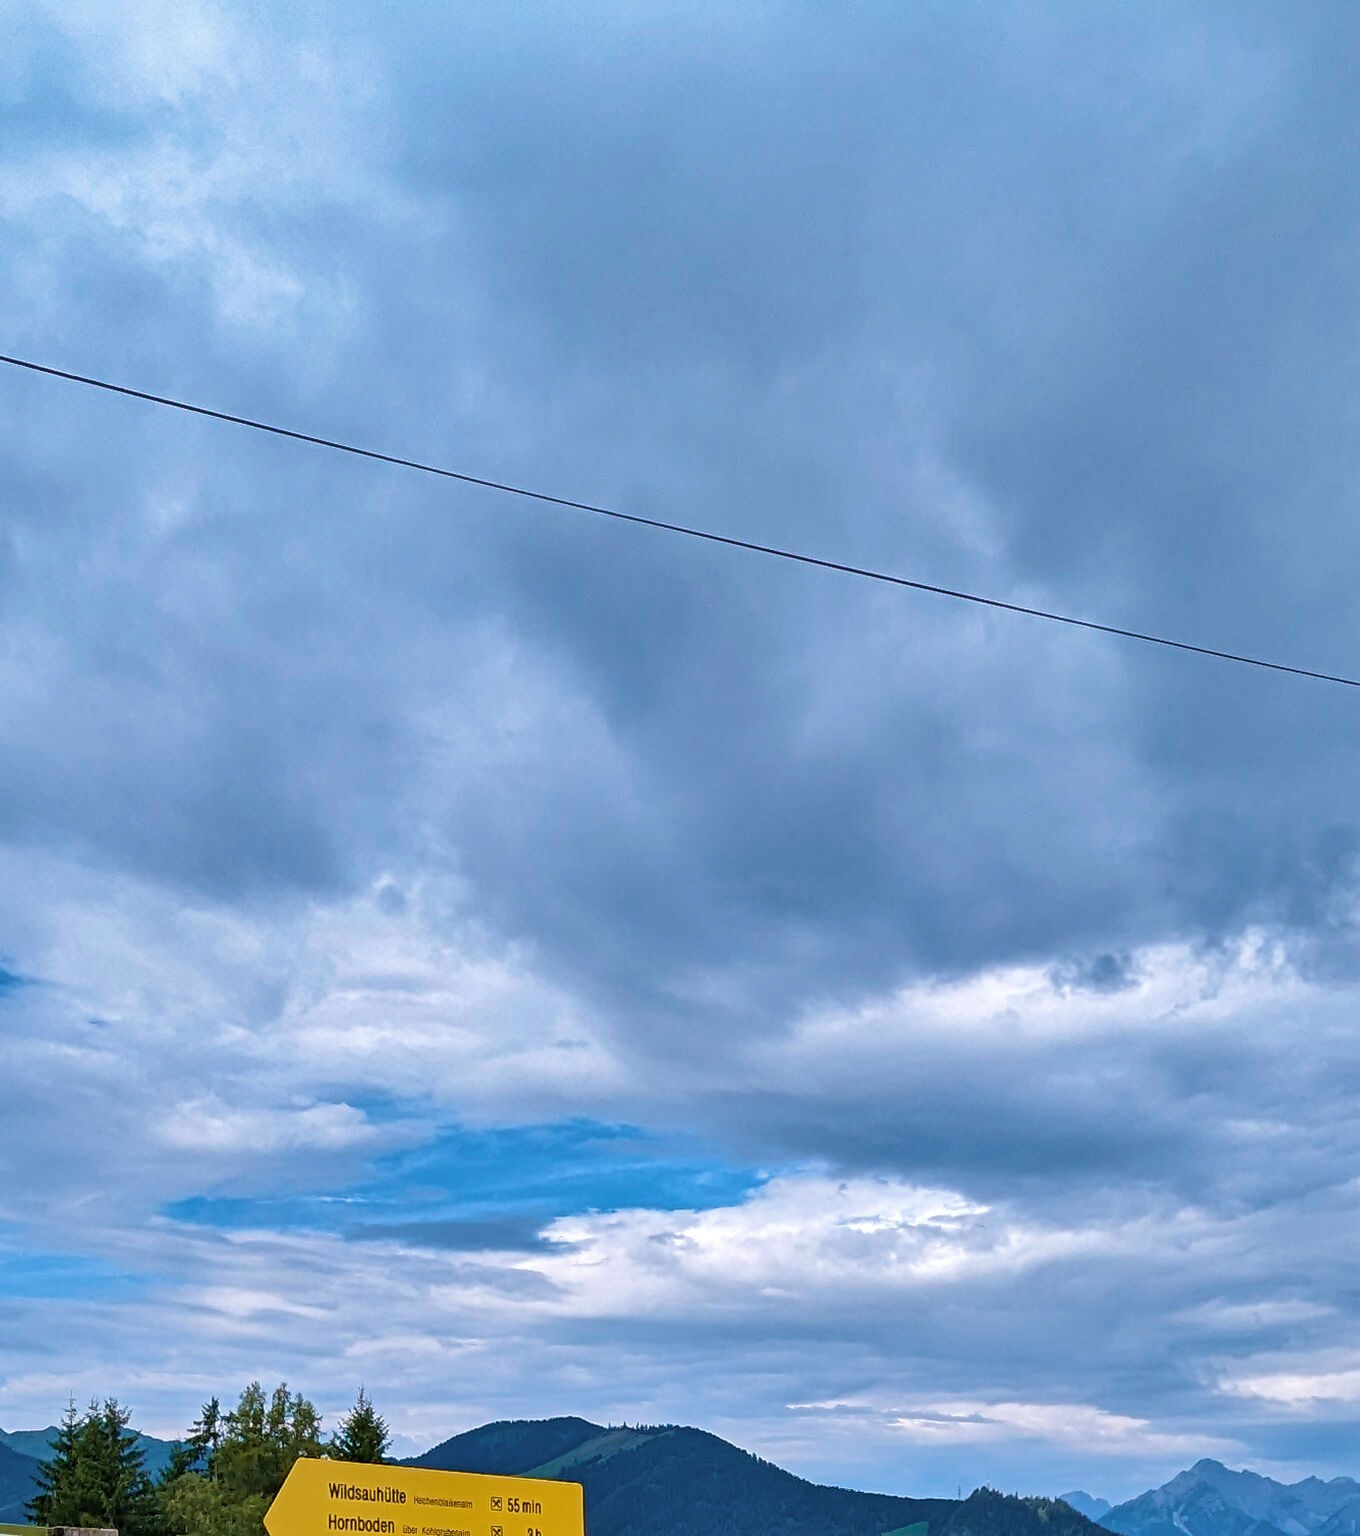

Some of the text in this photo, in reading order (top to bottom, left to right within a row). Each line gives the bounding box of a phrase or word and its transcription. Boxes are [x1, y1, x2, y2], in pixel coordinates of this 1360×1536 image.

[328, 1482, 407, 1505] Wildsauhütte
[507, 1497, 520, 1513] 55
[522, 1500, 542, 1515] min
[328, 1513, 395, 1535] Hornboden
